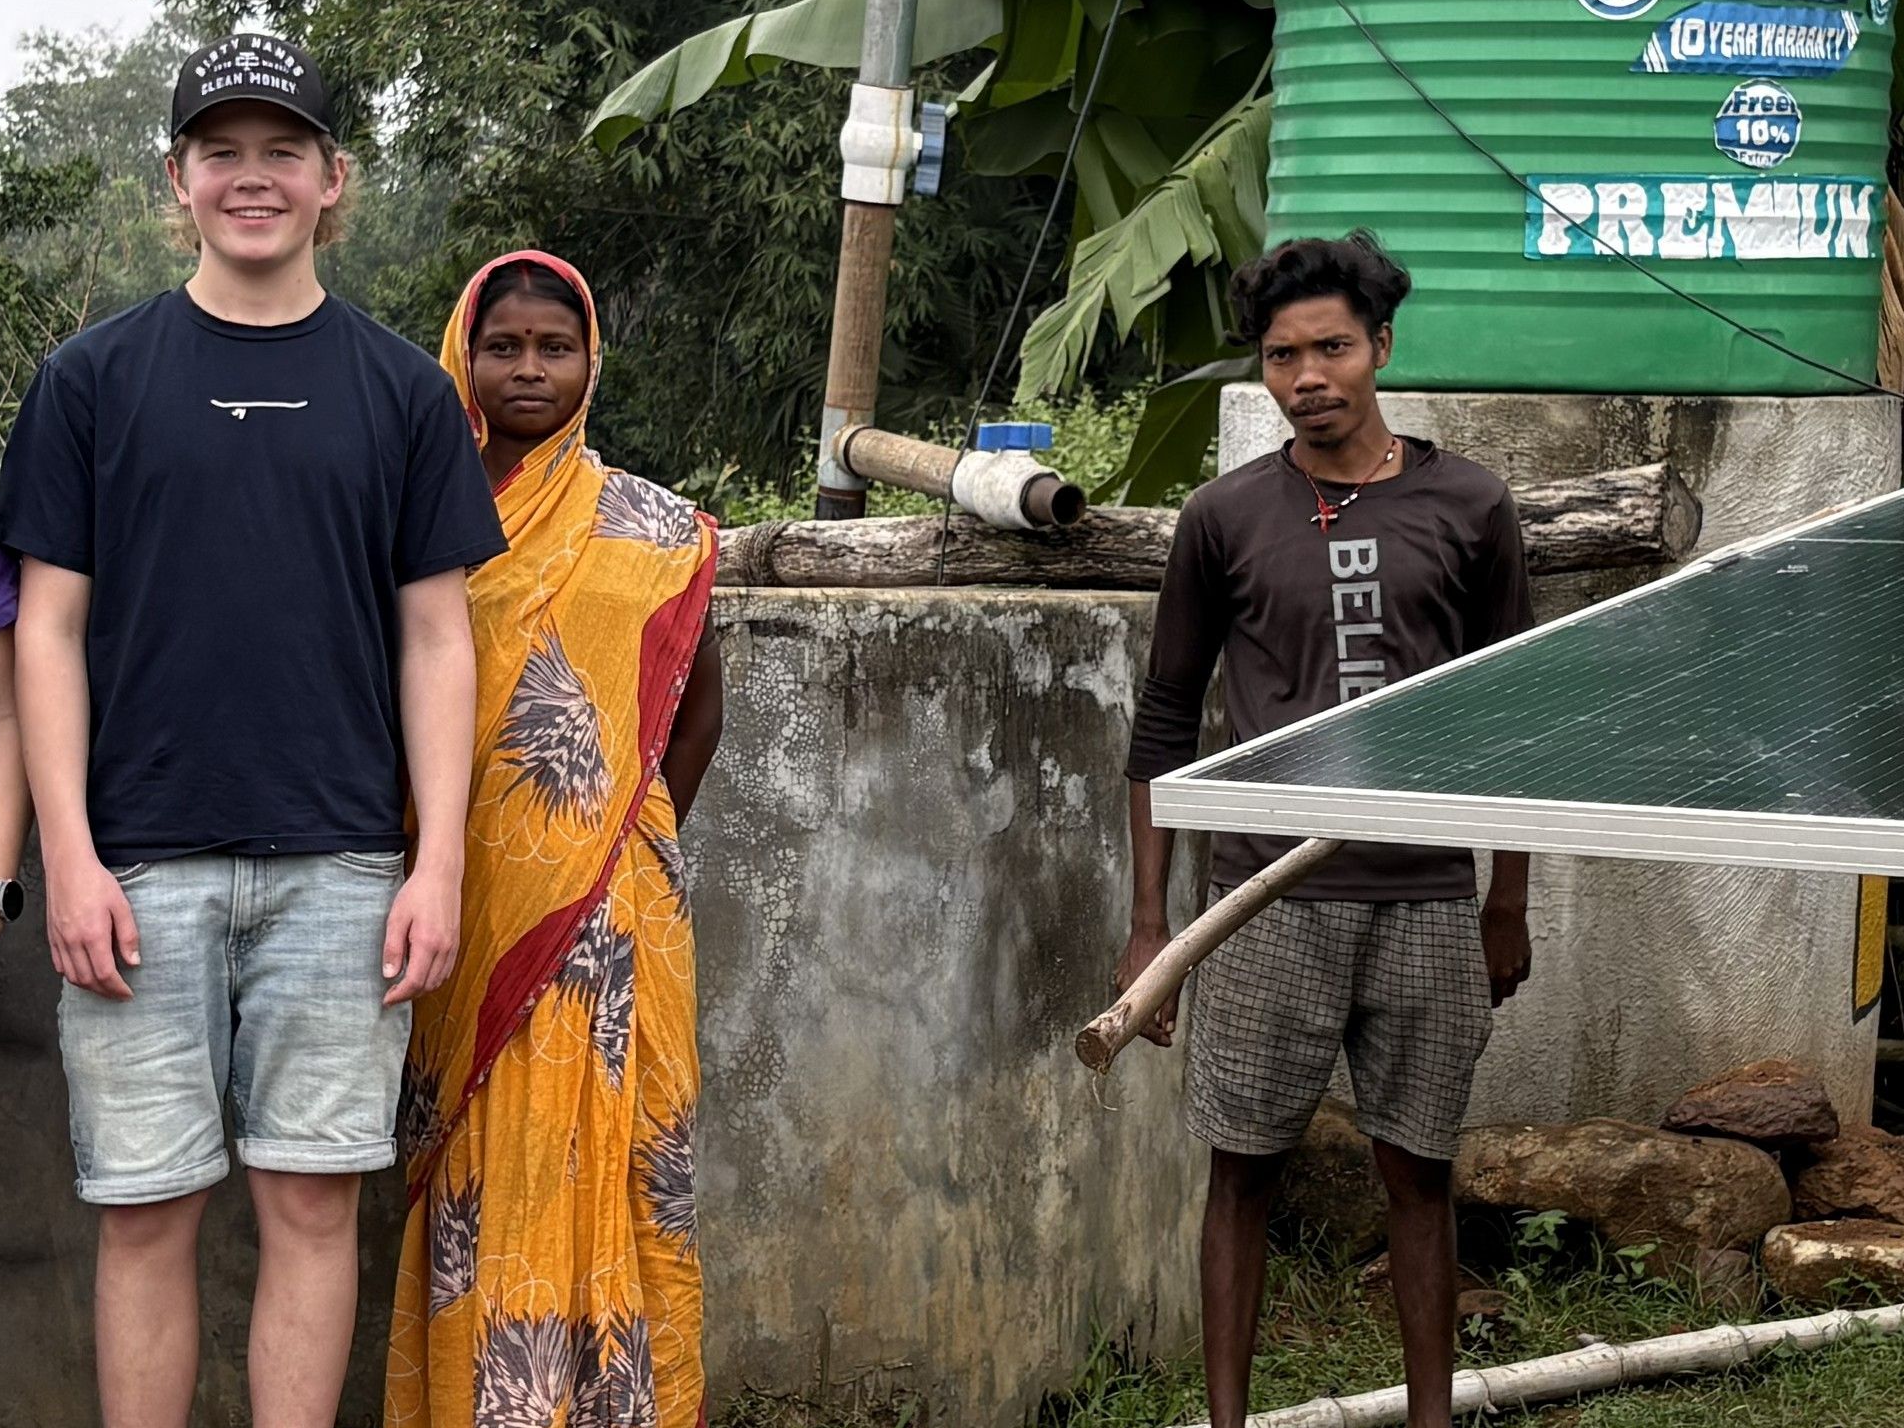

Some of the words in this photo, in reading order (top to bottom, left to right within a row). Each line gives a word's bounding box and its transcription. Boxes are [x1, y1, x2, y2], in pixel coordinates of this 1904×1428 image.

[1670, 18, 1705, 60] 10
[1709, 22, 1758, 57] YEAR
[1761, 23, 1845, 60] WARRANTY
[196, 38, 239, 77] DIRTY
[201, 72, 243, 95] CLEAN
[249, 72, 296, 94] MONEY
[1733, 91, 1789, 112] Free
[1736, 119, 1790, 145] 10%
